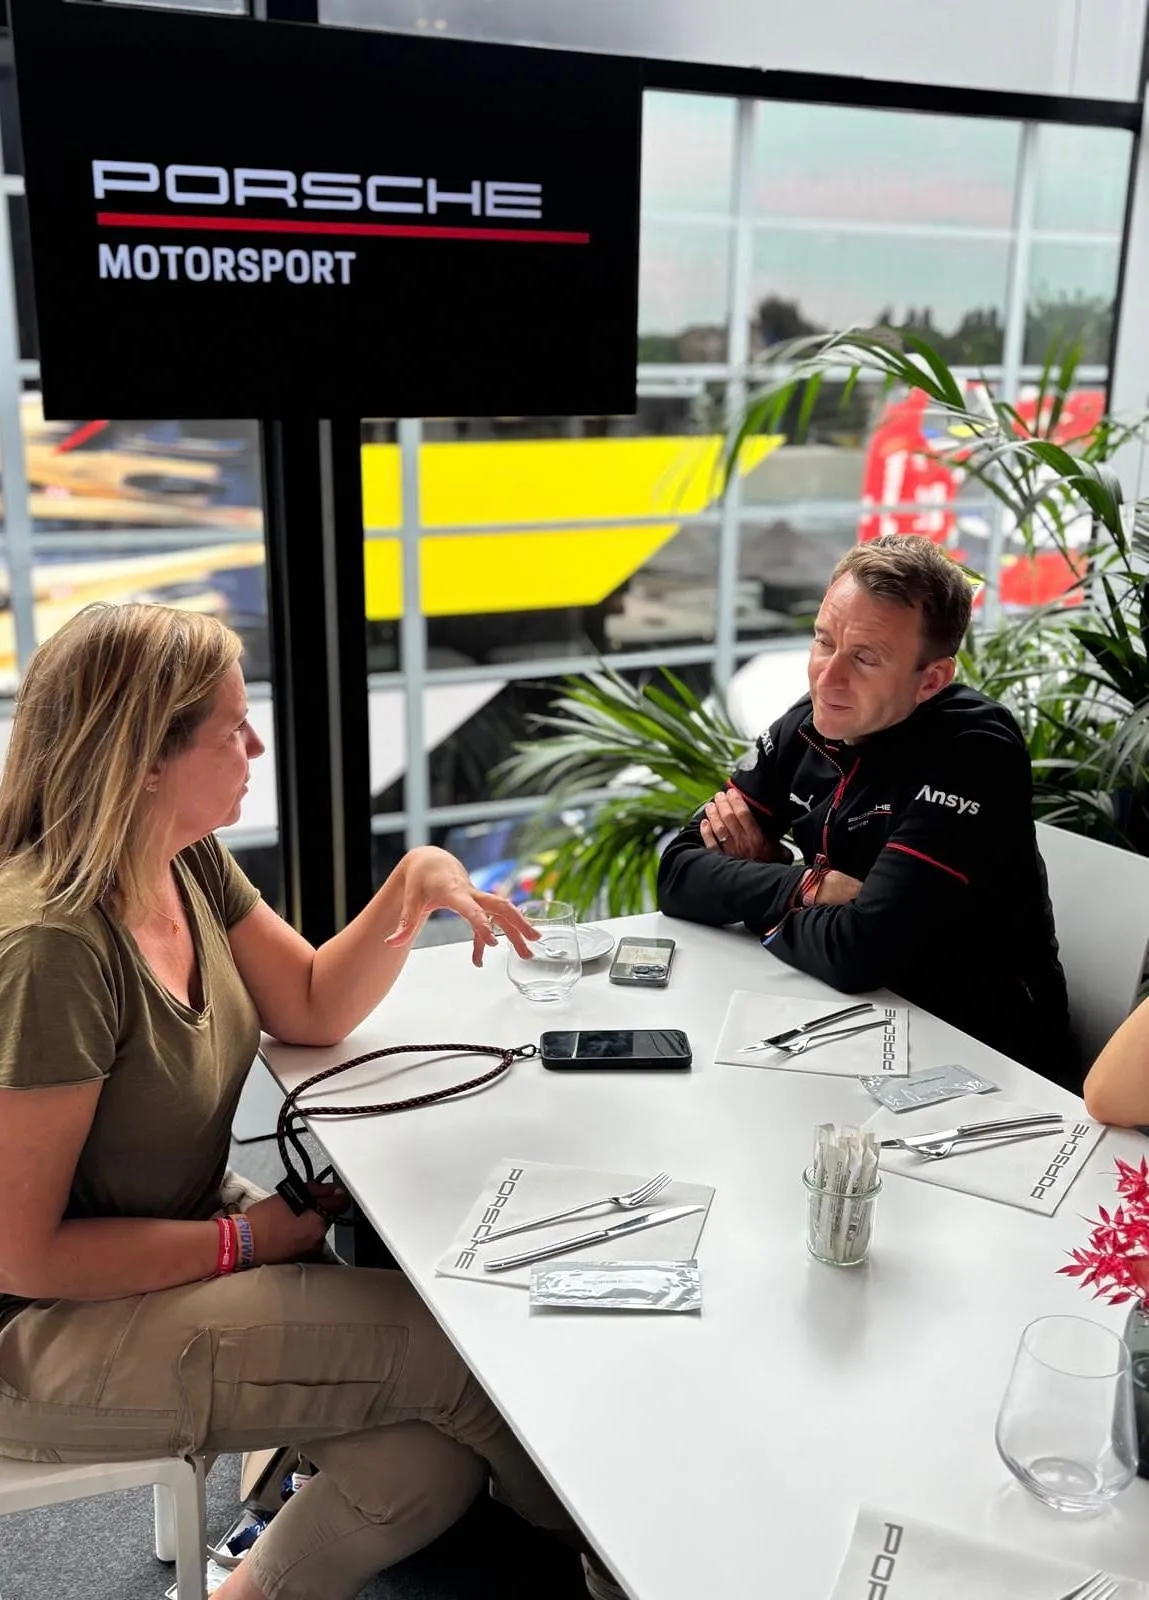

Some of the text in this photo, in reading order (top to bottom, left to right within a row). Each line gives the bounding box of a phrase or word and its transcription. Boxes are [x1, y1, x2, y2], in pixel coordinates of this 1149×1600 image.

[92, 159, 543, 219] PORSCHE
[98, 243, 357, 284] MOTORSPORT
[914, 784, 981, 815] Ansys
[883, 1009, 896, 1071] PORSCHE
[1030, 1123, 1091, 1200] PORSCHE
[454, 1167, 524, 1270] PORSCHE
